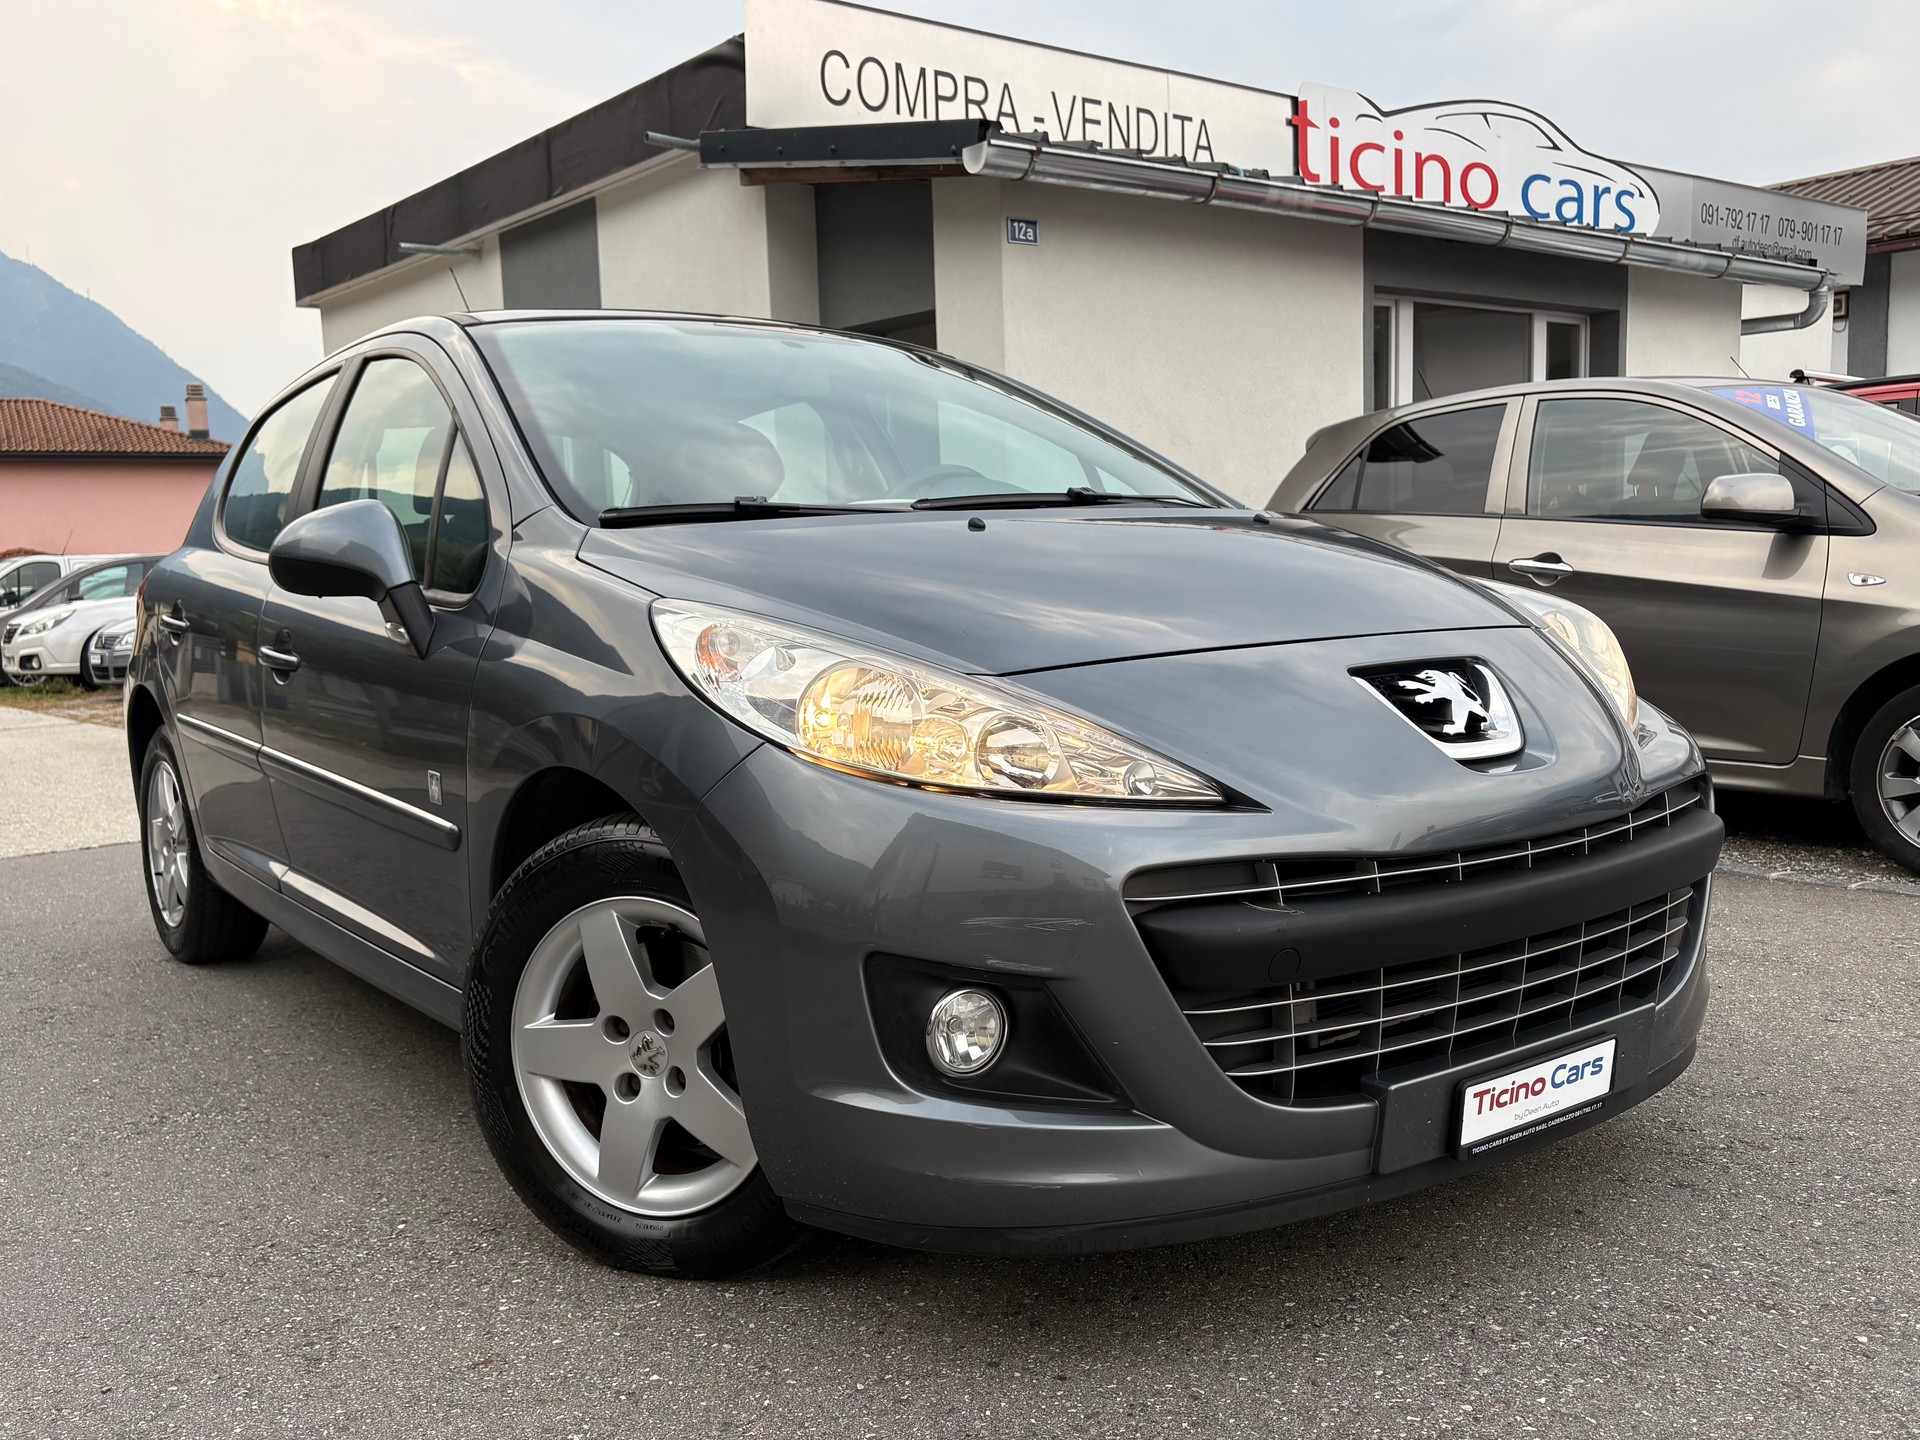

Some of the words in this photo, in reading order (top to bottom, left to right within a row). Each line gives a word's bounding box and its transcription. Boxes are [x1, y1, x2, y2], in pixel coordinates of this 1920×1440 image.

[820, 49, 1022, 134] COMPRA
[1290, 99, 1499, 210] ticino
[1520, 172, 1637, 234] cars
[1012, 221, 1035, 241] 12a
[1731, 235, 1813, 259] dfautodeen@gmailcom
[1473, 1076, 1547, 1116] Ticino
[1550, 1056, 1604, 1089] Cars
[1514, 1112, 1524, 1122] by
[1542, 1099, 1560, 1111] Auto
[1472, 1143, 1489, 1155] TICINO
[1488, 1138, 1503, 1149] CARS
[1522, 1127, 1536, 1137] AUTO
